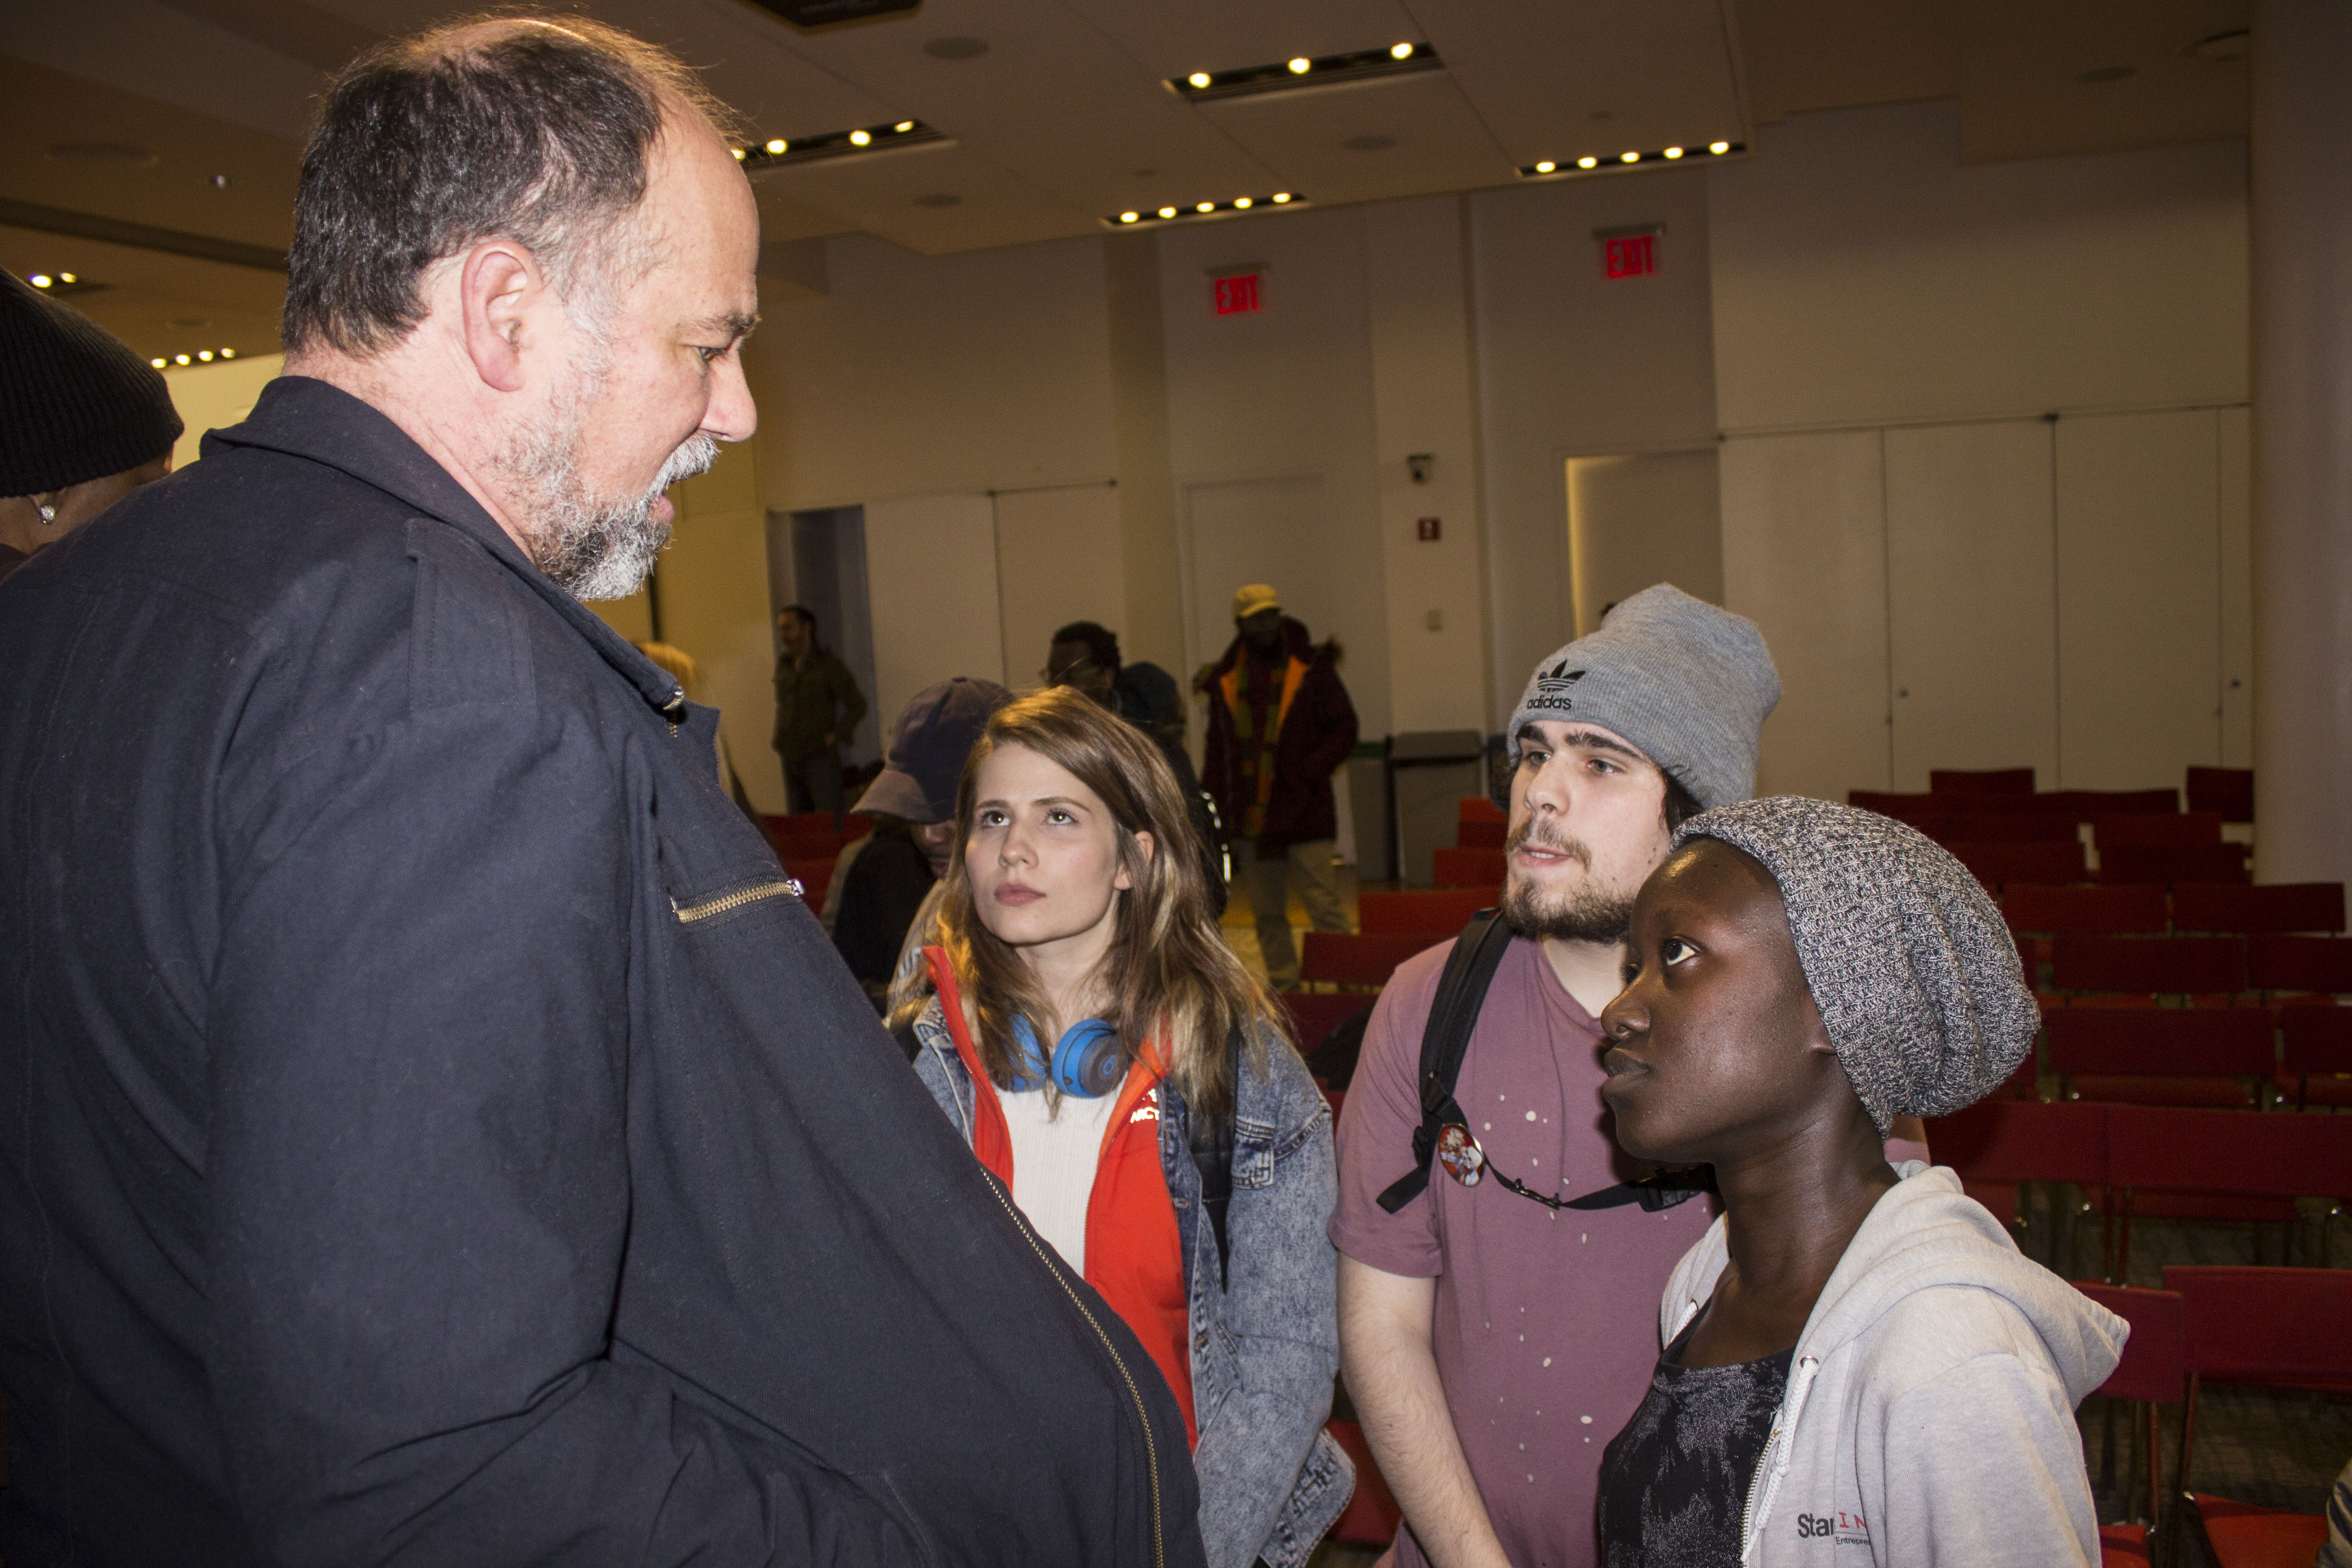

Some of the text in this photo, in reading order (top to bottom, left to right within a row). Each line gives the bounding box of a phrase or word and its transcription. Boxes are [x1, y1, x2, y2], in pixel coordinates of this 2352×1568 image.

[1607, 236, 1654, 278] EXIT
[1216, 274, 1258, 314] EXIT
[1527, 694, 1572, 710] adidas
